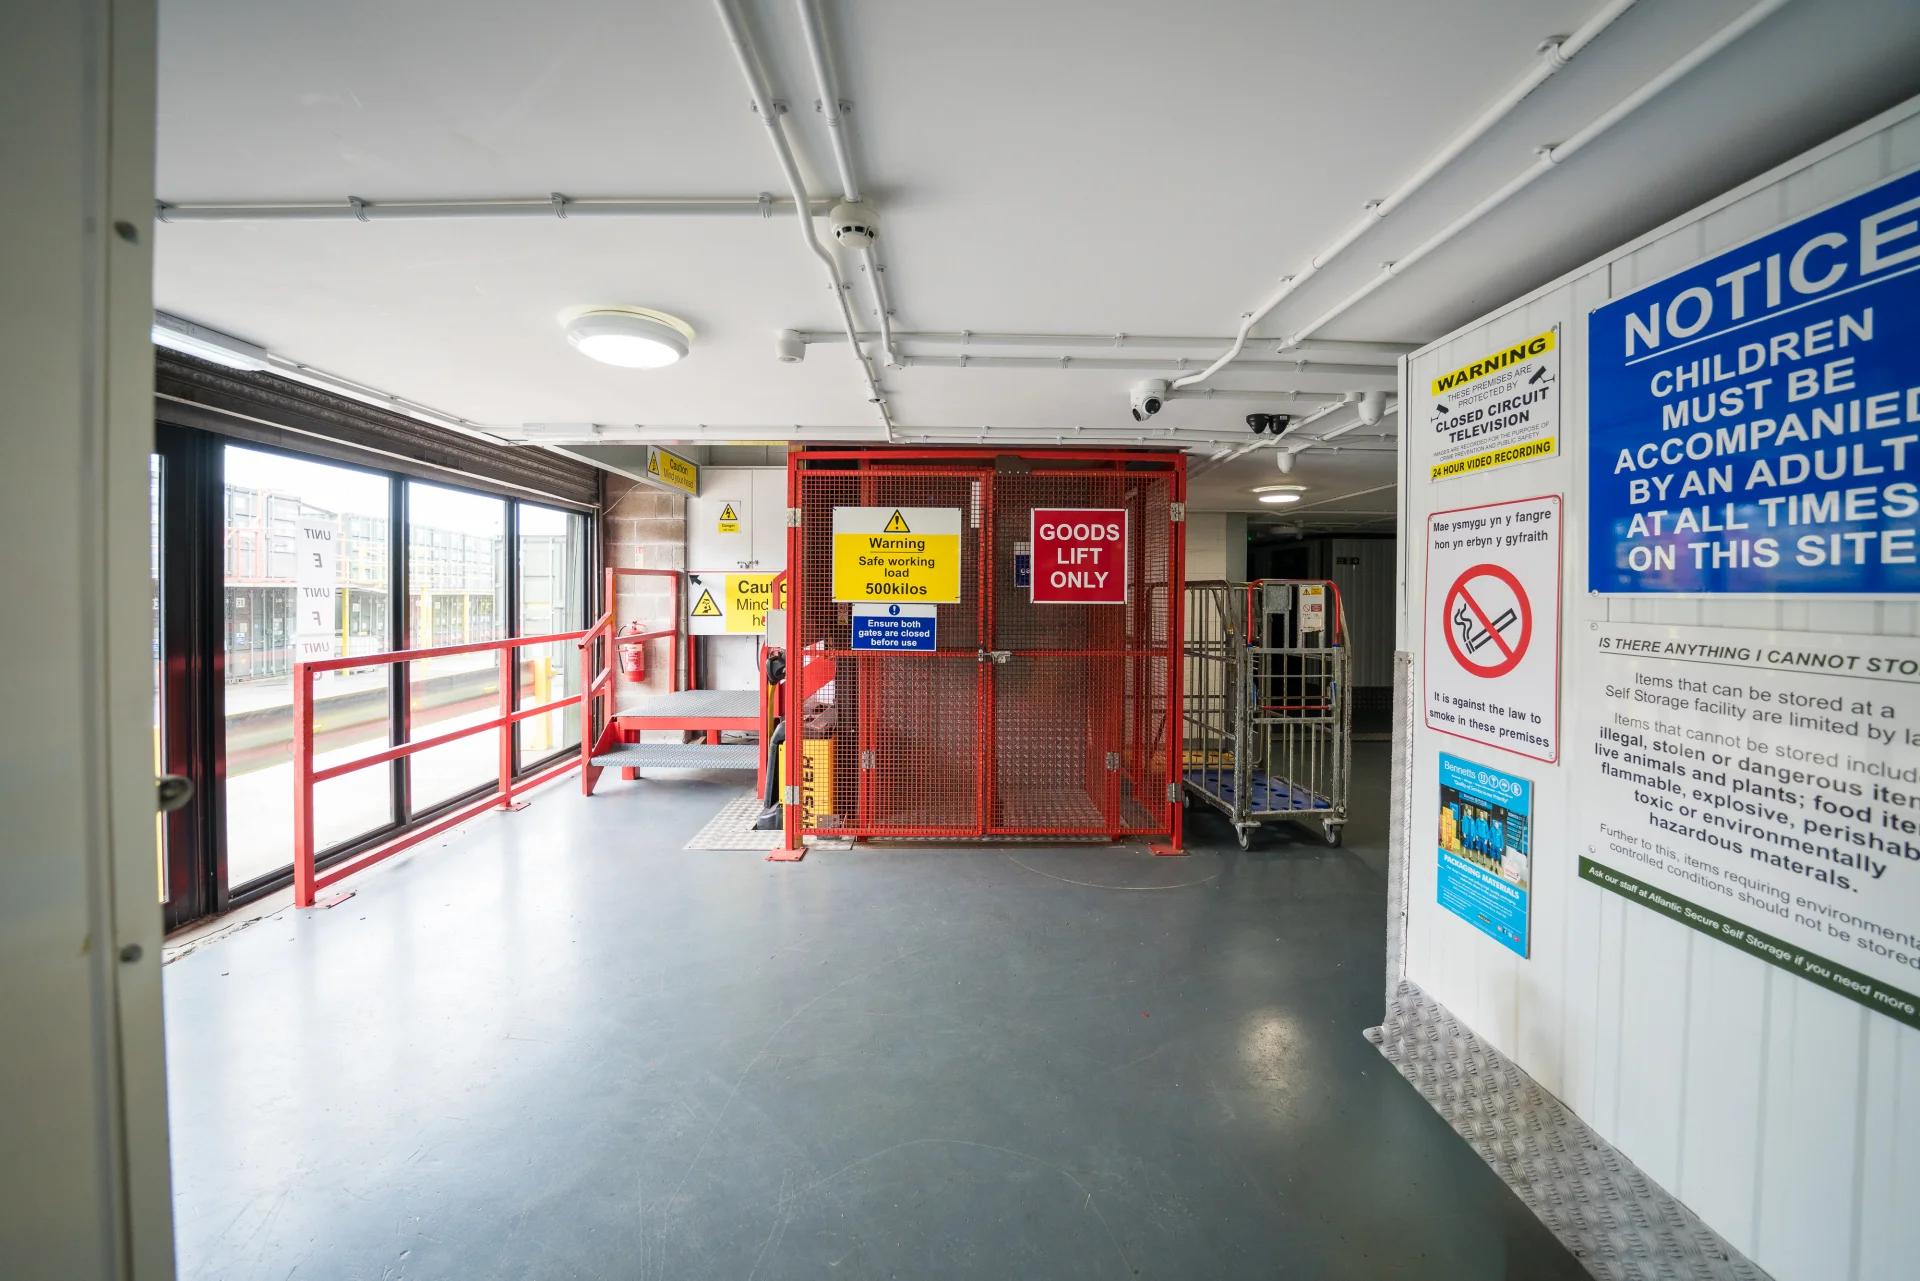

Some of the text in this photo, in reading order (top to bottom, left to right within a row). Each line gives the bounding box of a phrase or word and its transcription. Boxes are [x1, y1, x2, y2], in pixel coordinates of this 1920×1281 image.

[1625, 197, 1920, 356] NOTICE
[1438, 338, 1546, 392] WARNING
[1650, 307, 1873, 398] CHILDREN
[1448, 364, 1532, 402] THESE PREMISES ARE
[1458, 380, 1518, 408] PROTECTED BY
[1662, 357, 1856, 431] MUST BE
[1436, 386, 1549, 433] CLOSED CIRCUIT
[1449, 410, 1529, 443] TELEVISION
[664, 468, 693, 488] Mind your head
[670, 459, 688, 475] Caution
[1433, 441, 1550, 478] 24 HOUR VIDEO RECORDING
[1629, 436, 1909, 505] BY AN ADULT
[1433, 510, 1552, 532] Mae ysmygu yn y fangre
[1626, 481, 1920, 539] AT ALL TIMES
[869, 537, 925, 551] Warning
[1039, 523, 1120, 541] GOODS
[1434, 530, 1548, 550] hon yn erbyn y gyfraith
[1628, 528, 1917, 571] ON THIS SITE
[859, 556, 935, 568] Safe working
[884, 568, 909, 578] load
[1057, 547, 1102, 565] LIFT
[865, 583, 927, 595] 500kilos
[1050, 571, 1109, 589] ONLY
[737, 599, 768, 610] Mind
[859, 630, 882, 638] gates
[871, 638, 899, 646] before
[1599, 637, 1860, 670] IS THERE ANYTHING I CANNOT
[1434, 691, 1541, 724] It is against the law to
[1636, 672, 1894, 719] Items that can be stored at a
[1430, 710, 1550, 748] smoke in these premises
[1605, 684, 1896, 746] Self Storage facility are limited by
[1614, 712, 1838, 768] Items that cannot be stored
[1445, 761, 1476, 779] Bennetts
[1600, 726, 1863, 796] illegal, stolen or dangerous
[1595, 742, 1871, 824] live animals and plants; food
[1601, 762, 1686, 798] flammable,
[1692, 790, 1794, 829] explosive,
[1634, 790, 1887, 878] toxic or environmentally
[1650, 812, 1857, 893] hazardous materals.
[1444, 854, 1480, 878] PACKAGING
[1482, 874, 1519, 899] MATERIALS
[1600, 823, 1790, 904] Further to this, items requiring
[1610, 842, 1920, 970] controlled conditions should not be stored
[1588, 866, 1914, 1014] Ask our staff at Atlantic Secure Self Storage if you need more
